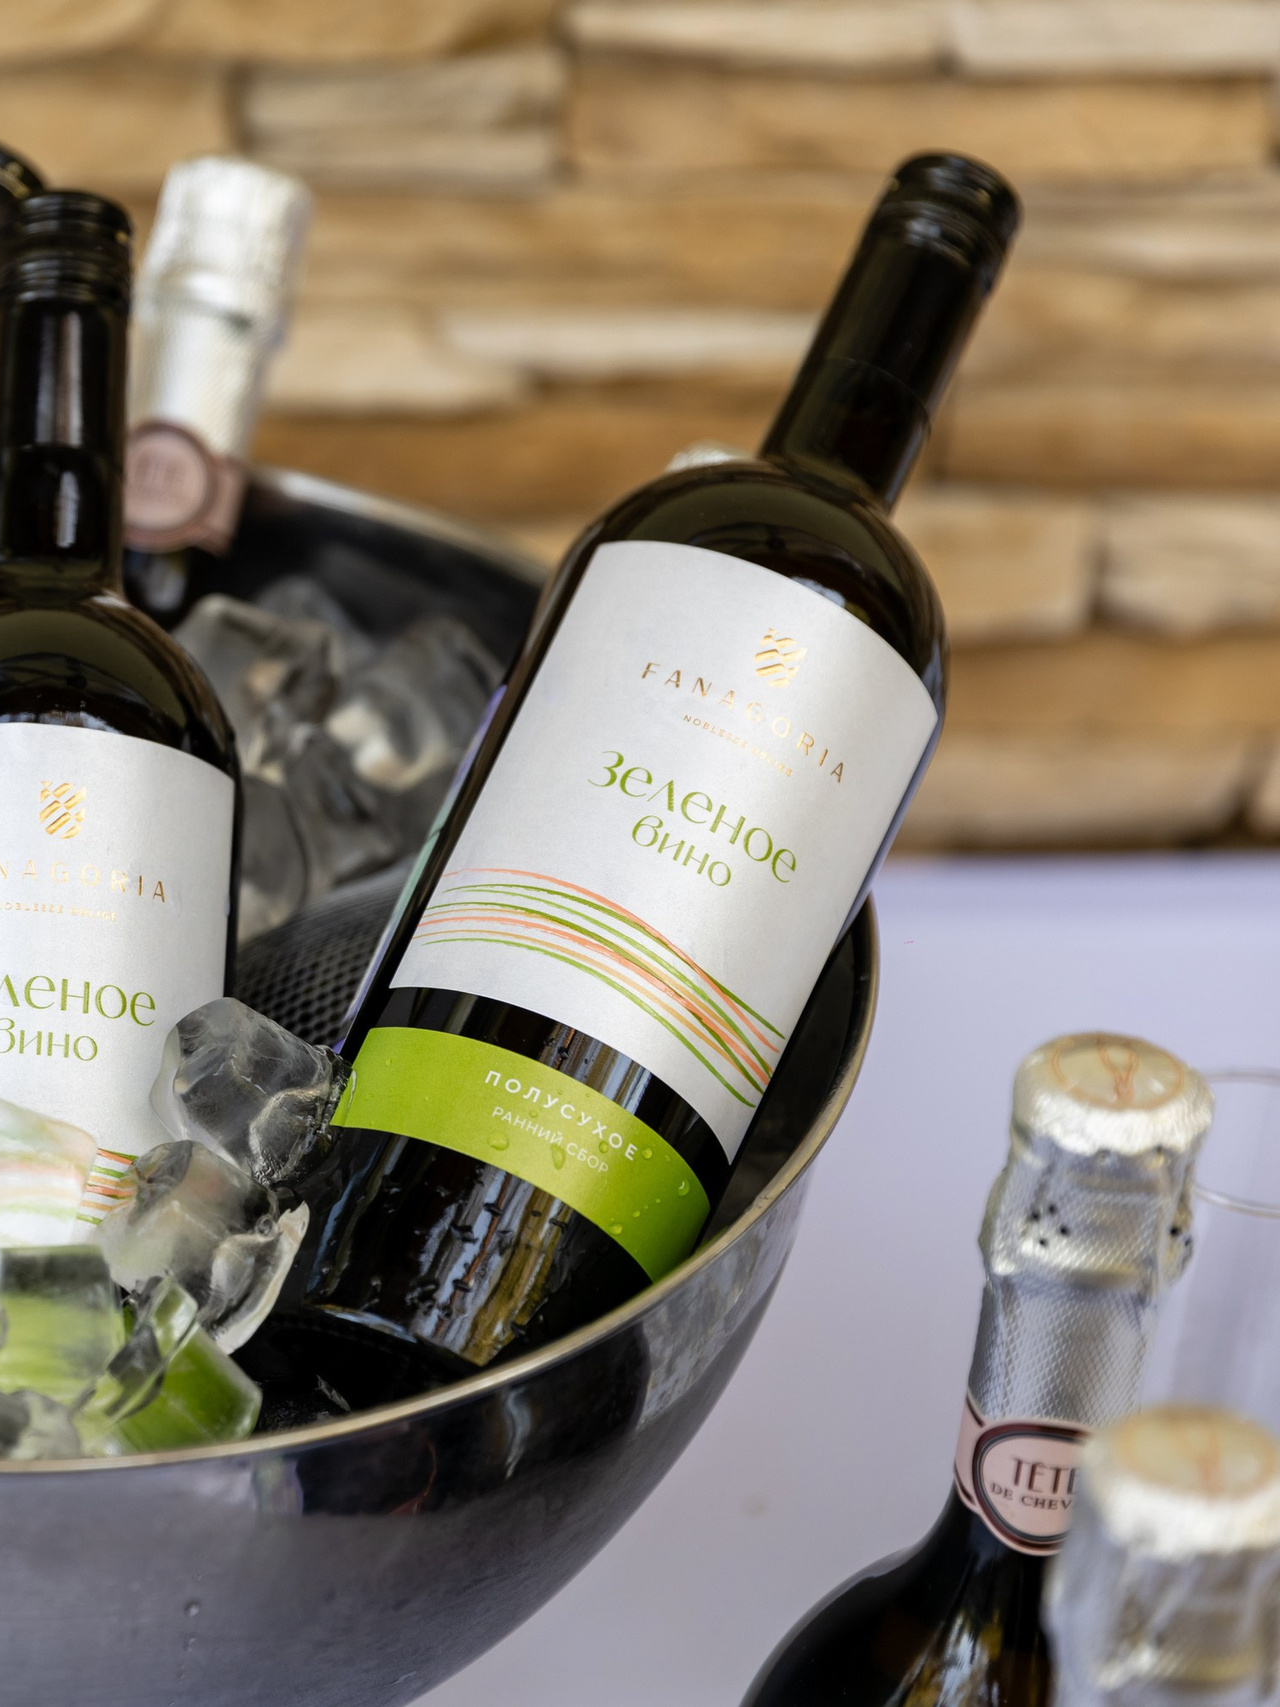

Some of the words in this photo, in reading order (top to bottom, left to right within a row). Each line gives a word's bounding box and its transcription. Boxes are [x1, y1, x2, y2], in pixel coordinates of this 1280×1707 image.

[641, 662, 844, 783] FANAGORIA
[588, 751, 797, 883] Зеленое
[631, 815, 732, 887] вино
[485, 1070, 638, 1161] ПОЛУСУХОЕ
[492, 1106, 564, 1147] РАННИЙ
[566, 1142, 609, 1174] СБОР
[991, 1482, 1014, 1500] DE
